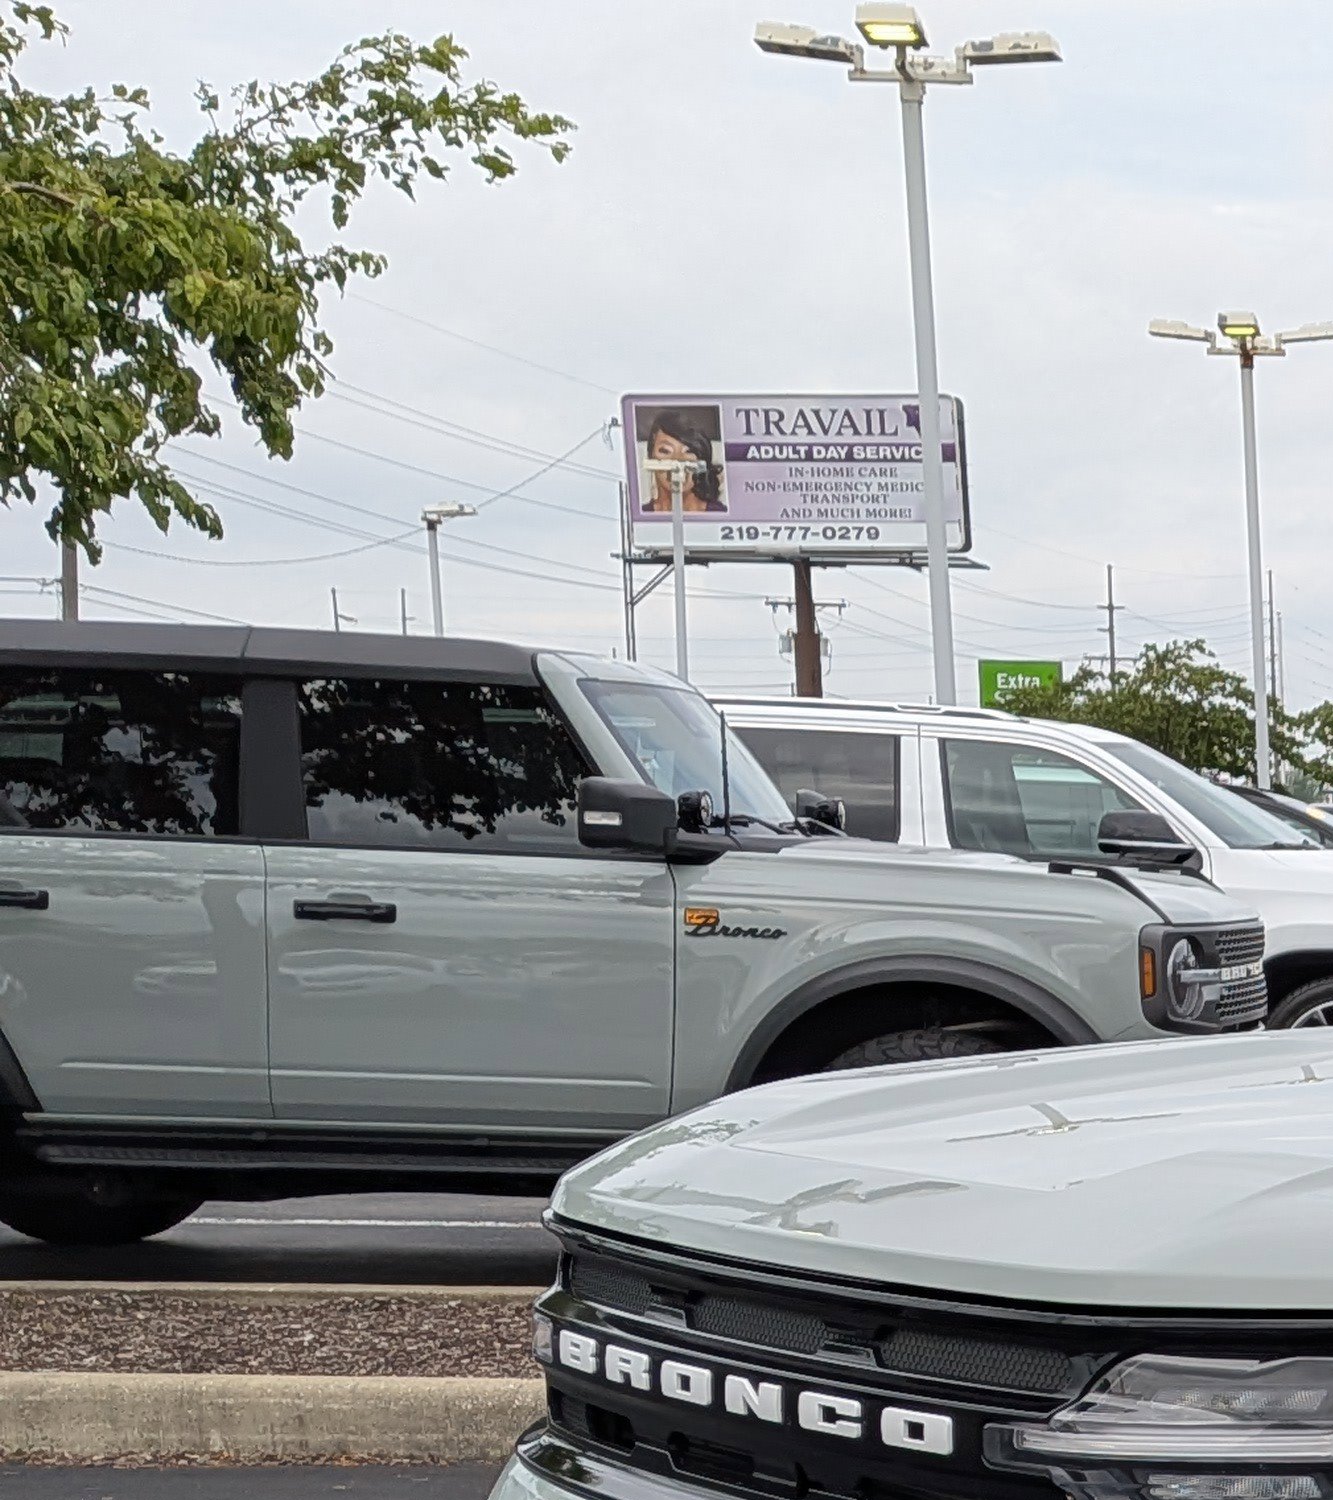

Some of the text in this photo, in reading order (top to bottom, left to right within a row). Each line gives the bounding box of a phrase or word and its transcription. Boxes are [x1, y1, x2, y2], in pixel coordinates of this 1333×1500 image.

[735, 408, 899, 436] TRAVAIL
[746, 445, 923, 460] ADULT DAY SERVIC
[858, 466, 898, 478] CARE
[877, 481, 924, 493] MEDIC
[801, 493, 890, 504] TRANSPORT
[780, 508, 813, 519] AND
[816, 508, 861, 519] MUCH
[720, 525, 880, 541] 219-777-0279
[996, 672, 1041, 689] Extra
[684, 914, 788, 939] Bronco
[558, 1329, 954, 1456] BRONCO
